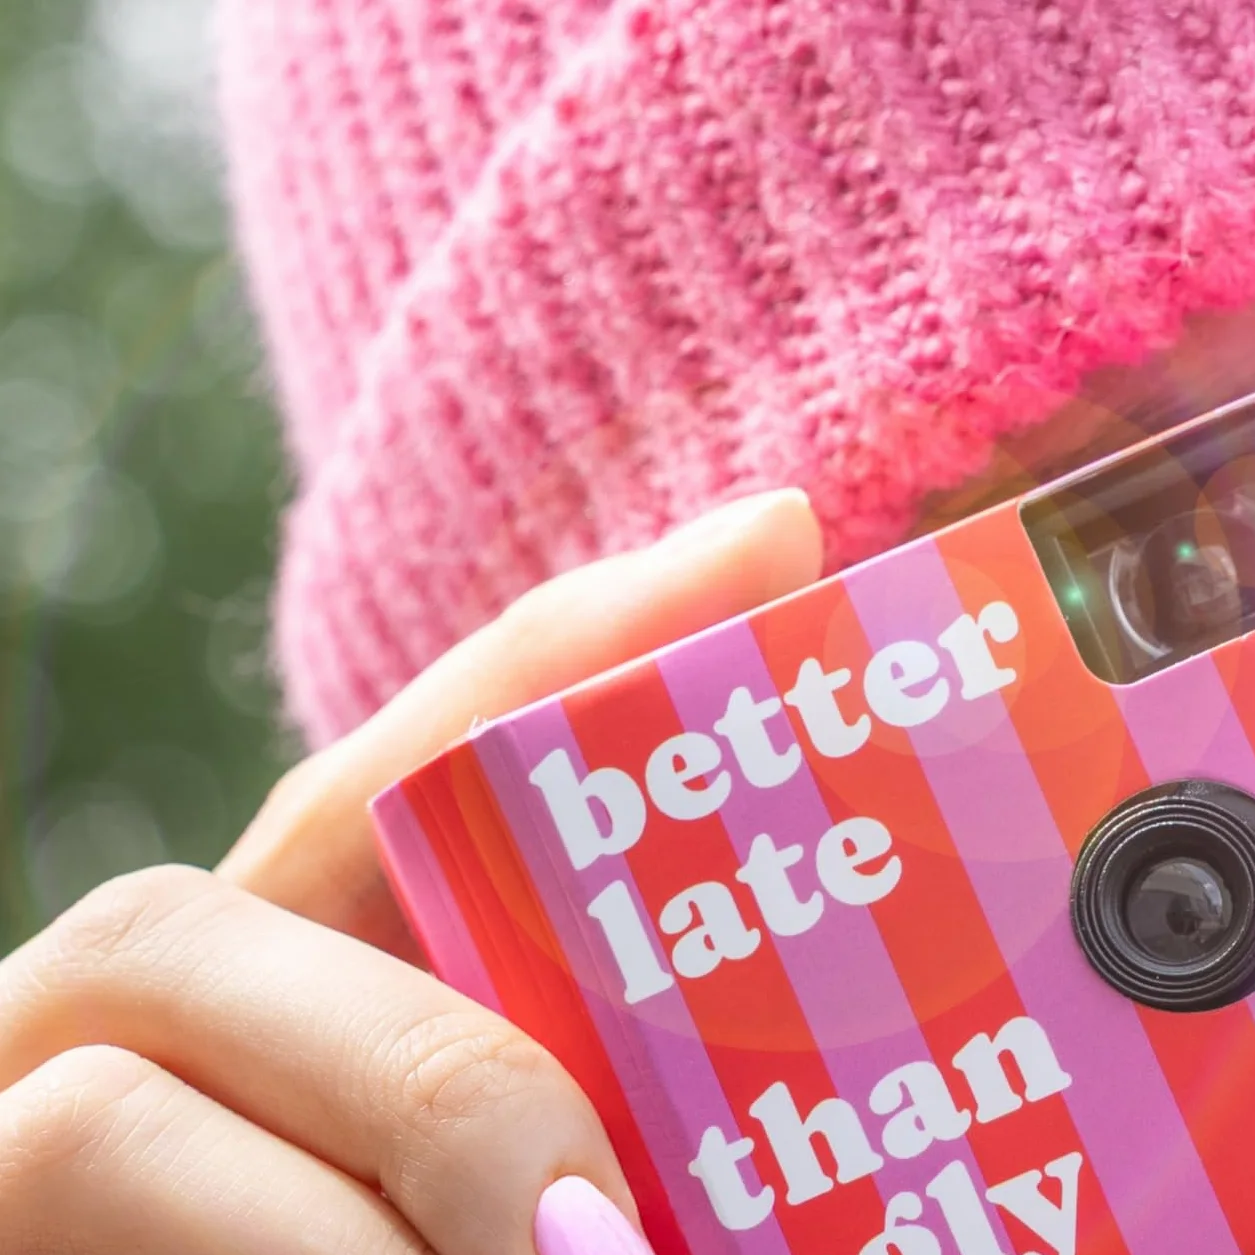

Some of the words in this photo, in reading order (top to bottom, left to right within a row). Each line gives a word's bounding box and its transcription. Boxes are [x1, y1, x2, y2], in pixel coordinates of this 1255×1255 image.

[530, 600, 1019, 870] better
[587, 816, 902, 1004] late
[691, 1016, 1072, 1231] than
